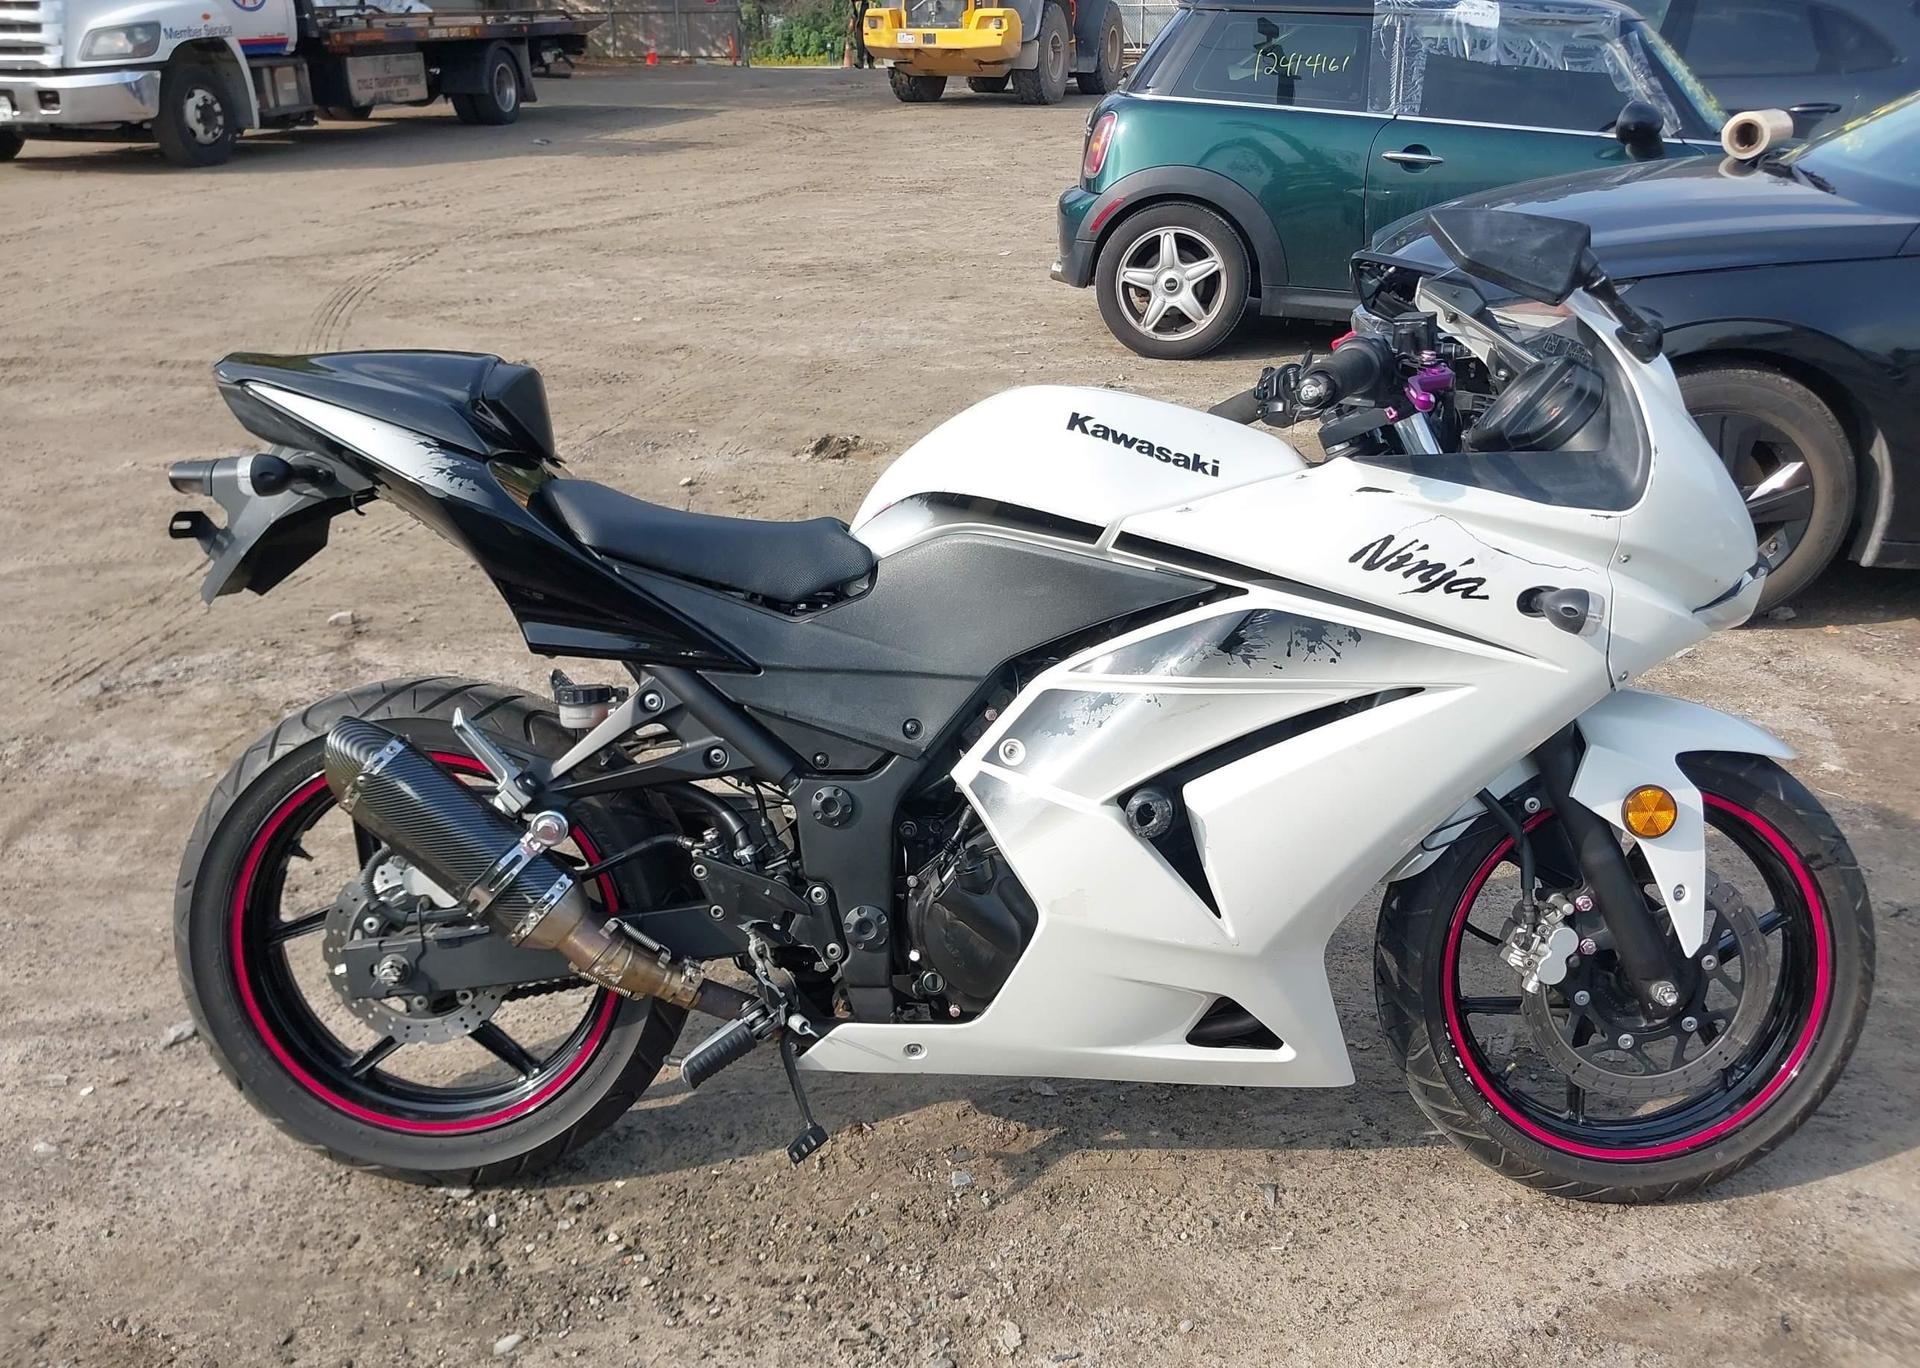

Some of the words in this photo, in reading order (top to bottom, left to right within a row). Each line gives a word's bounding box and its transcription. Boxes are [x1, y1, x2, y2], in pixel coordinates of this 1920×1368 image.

[163, 26, 202, 39] Member
[203, 23, 233, 36] Service
[1254, 49, 1350, 82] 12414161
[1066, 411, 1220, 478] Kawasaki
[1348, 534, 1489, 600] Ninja
